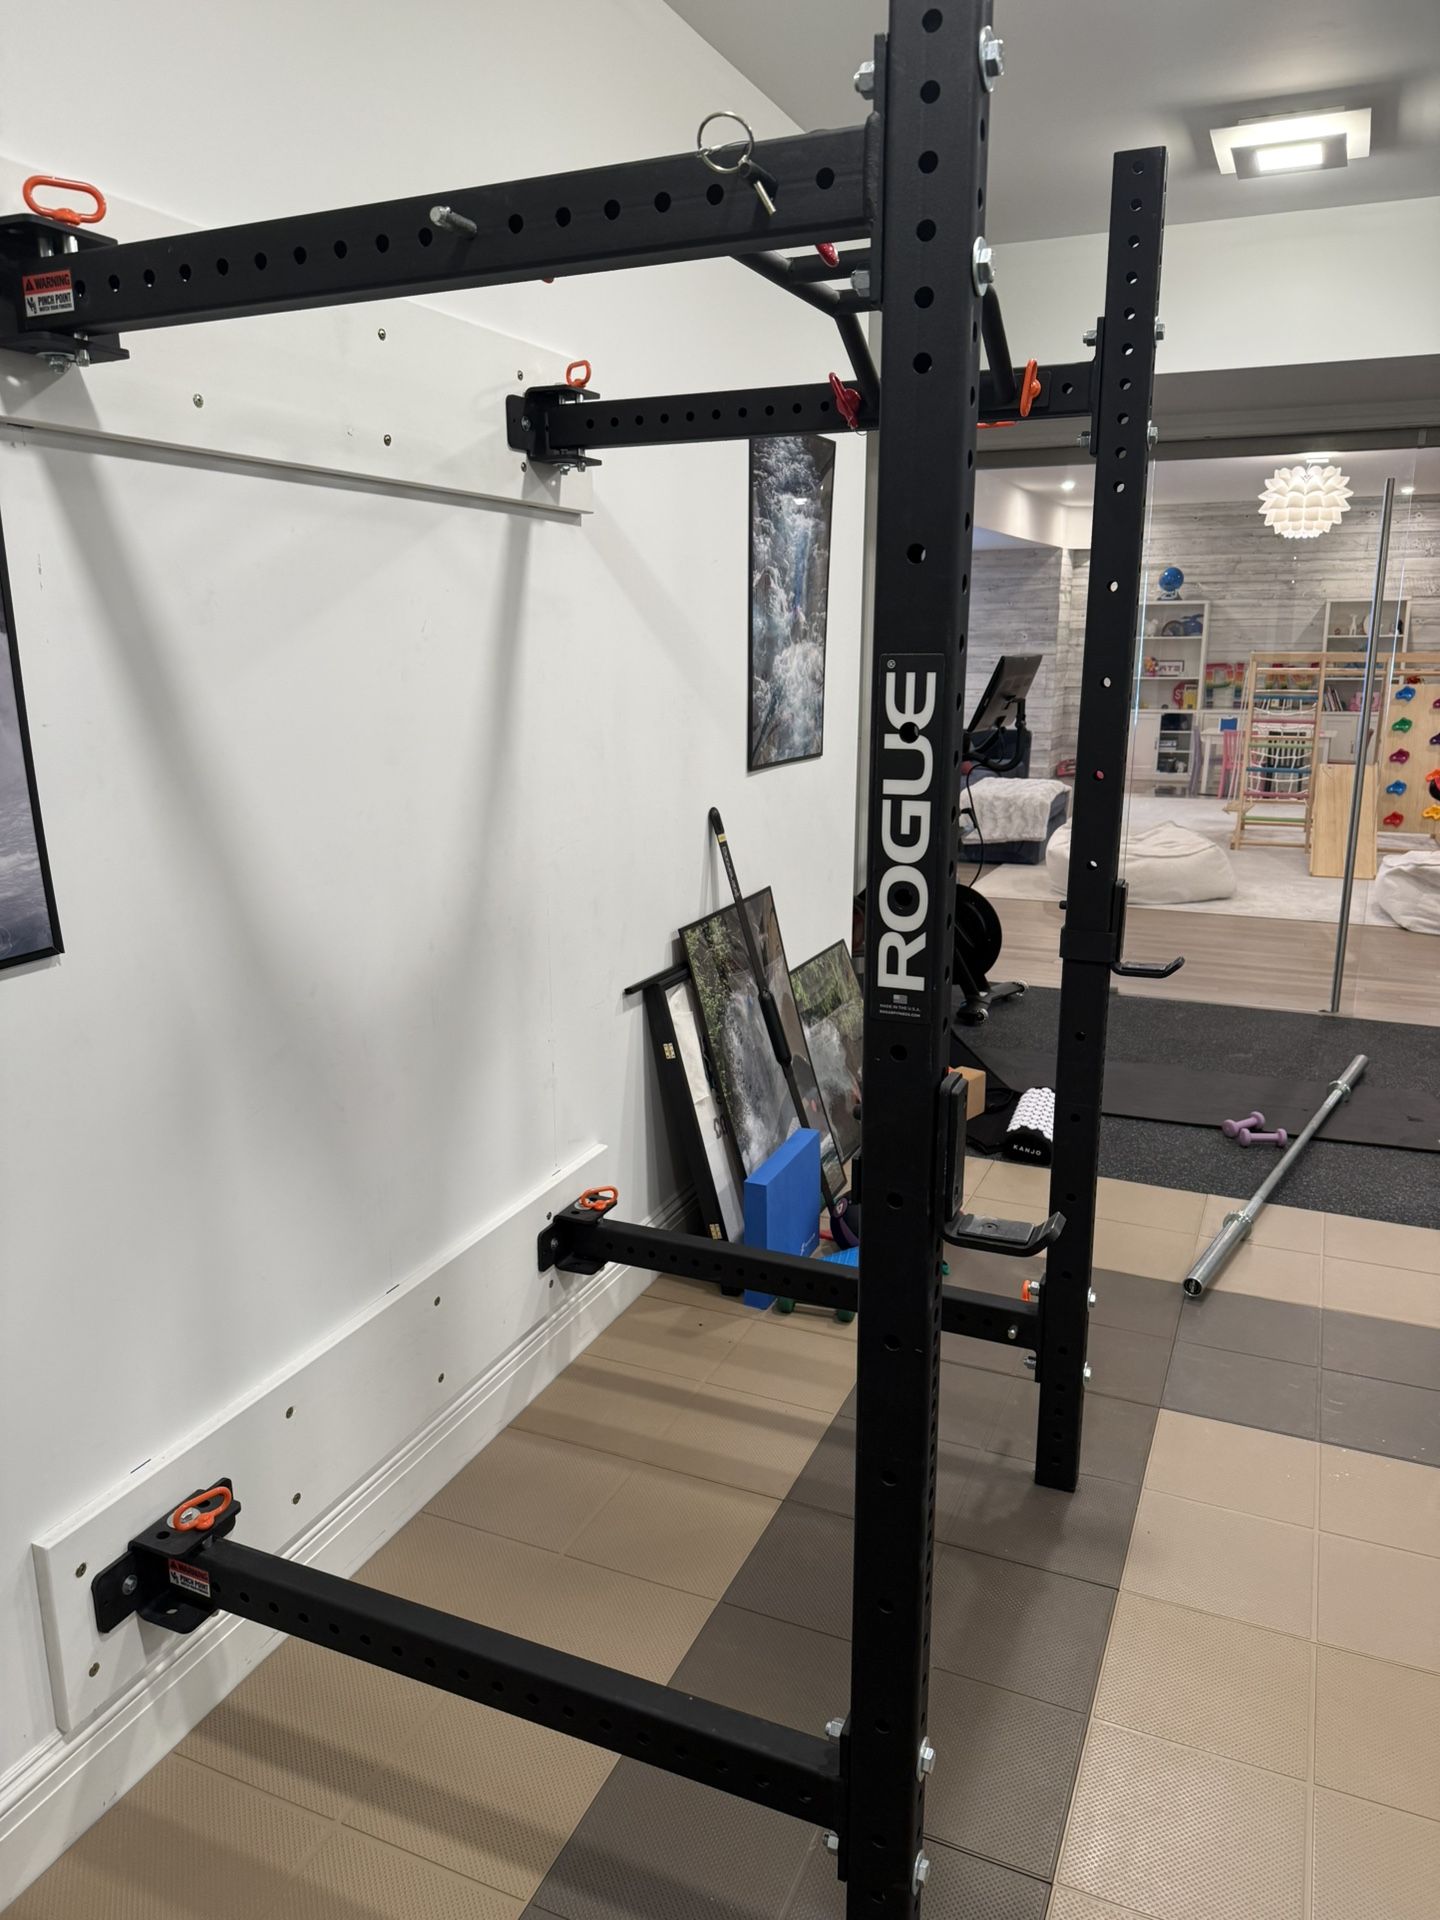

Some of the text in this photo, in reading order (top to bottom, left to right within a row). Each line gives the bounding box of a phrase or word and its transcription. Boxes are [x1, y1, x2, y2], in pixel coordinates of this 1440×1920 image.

[34, 274, 71, 290] WARNING
[38, 292, 71, 306] PINCH POINT
[877, 671, 937, 992] ROGUE
[1013, 1144, 1042, 1156] KANJO
